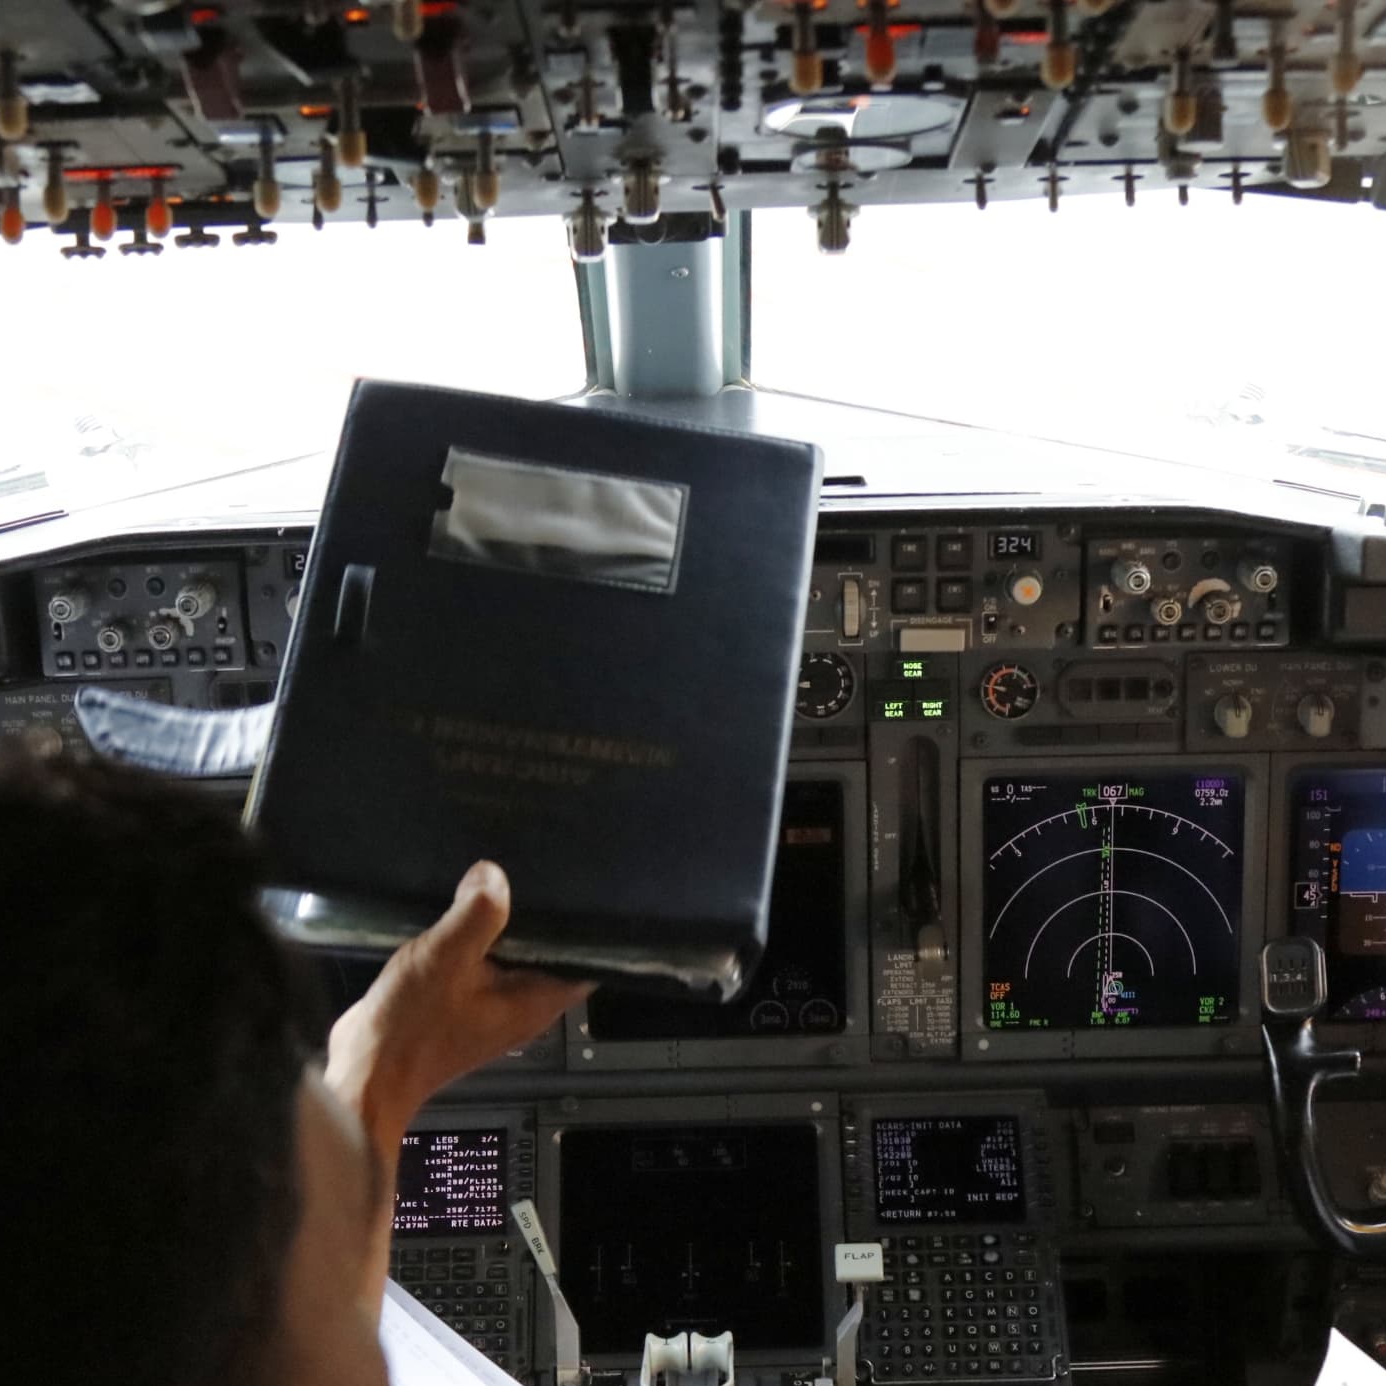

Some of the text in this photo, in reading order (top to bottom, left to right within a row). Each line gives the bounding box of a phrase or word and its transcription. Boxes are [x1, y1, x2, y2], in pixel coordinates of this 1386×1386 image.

[998, 537, 1031, 552] 324
[29, 694, 57, 704] PANEL
[885, 702, 902, 710] LEFT
[1082, 788, 1097, 797] TRK
[1102, 786, 1123, 797] 067
[1128, 787, 1145, 797] MAG
[1310, 790, 1328, 801] 151
[989, 983, 1011, 992] TCAS
[989, 991, 1005, 1000] OFF
[877, 998, 901, 1006] FLAPS
[1199, 996, 1215, 1005] VOR
[990, 1002, 1006, 1010] VOR
[991, 1010, 1021, 1018] 114.60
[939, 1120, 962, 1128] DATA
[403, 1137, 420, 1145] RTE
[436, 1136, 460, 1144] LEGS
[469, 1184, 504, 1192] BYPASS
[451, 1219, 469, 1228] RTE
[844, 1252, 875, 1260] FLAP
